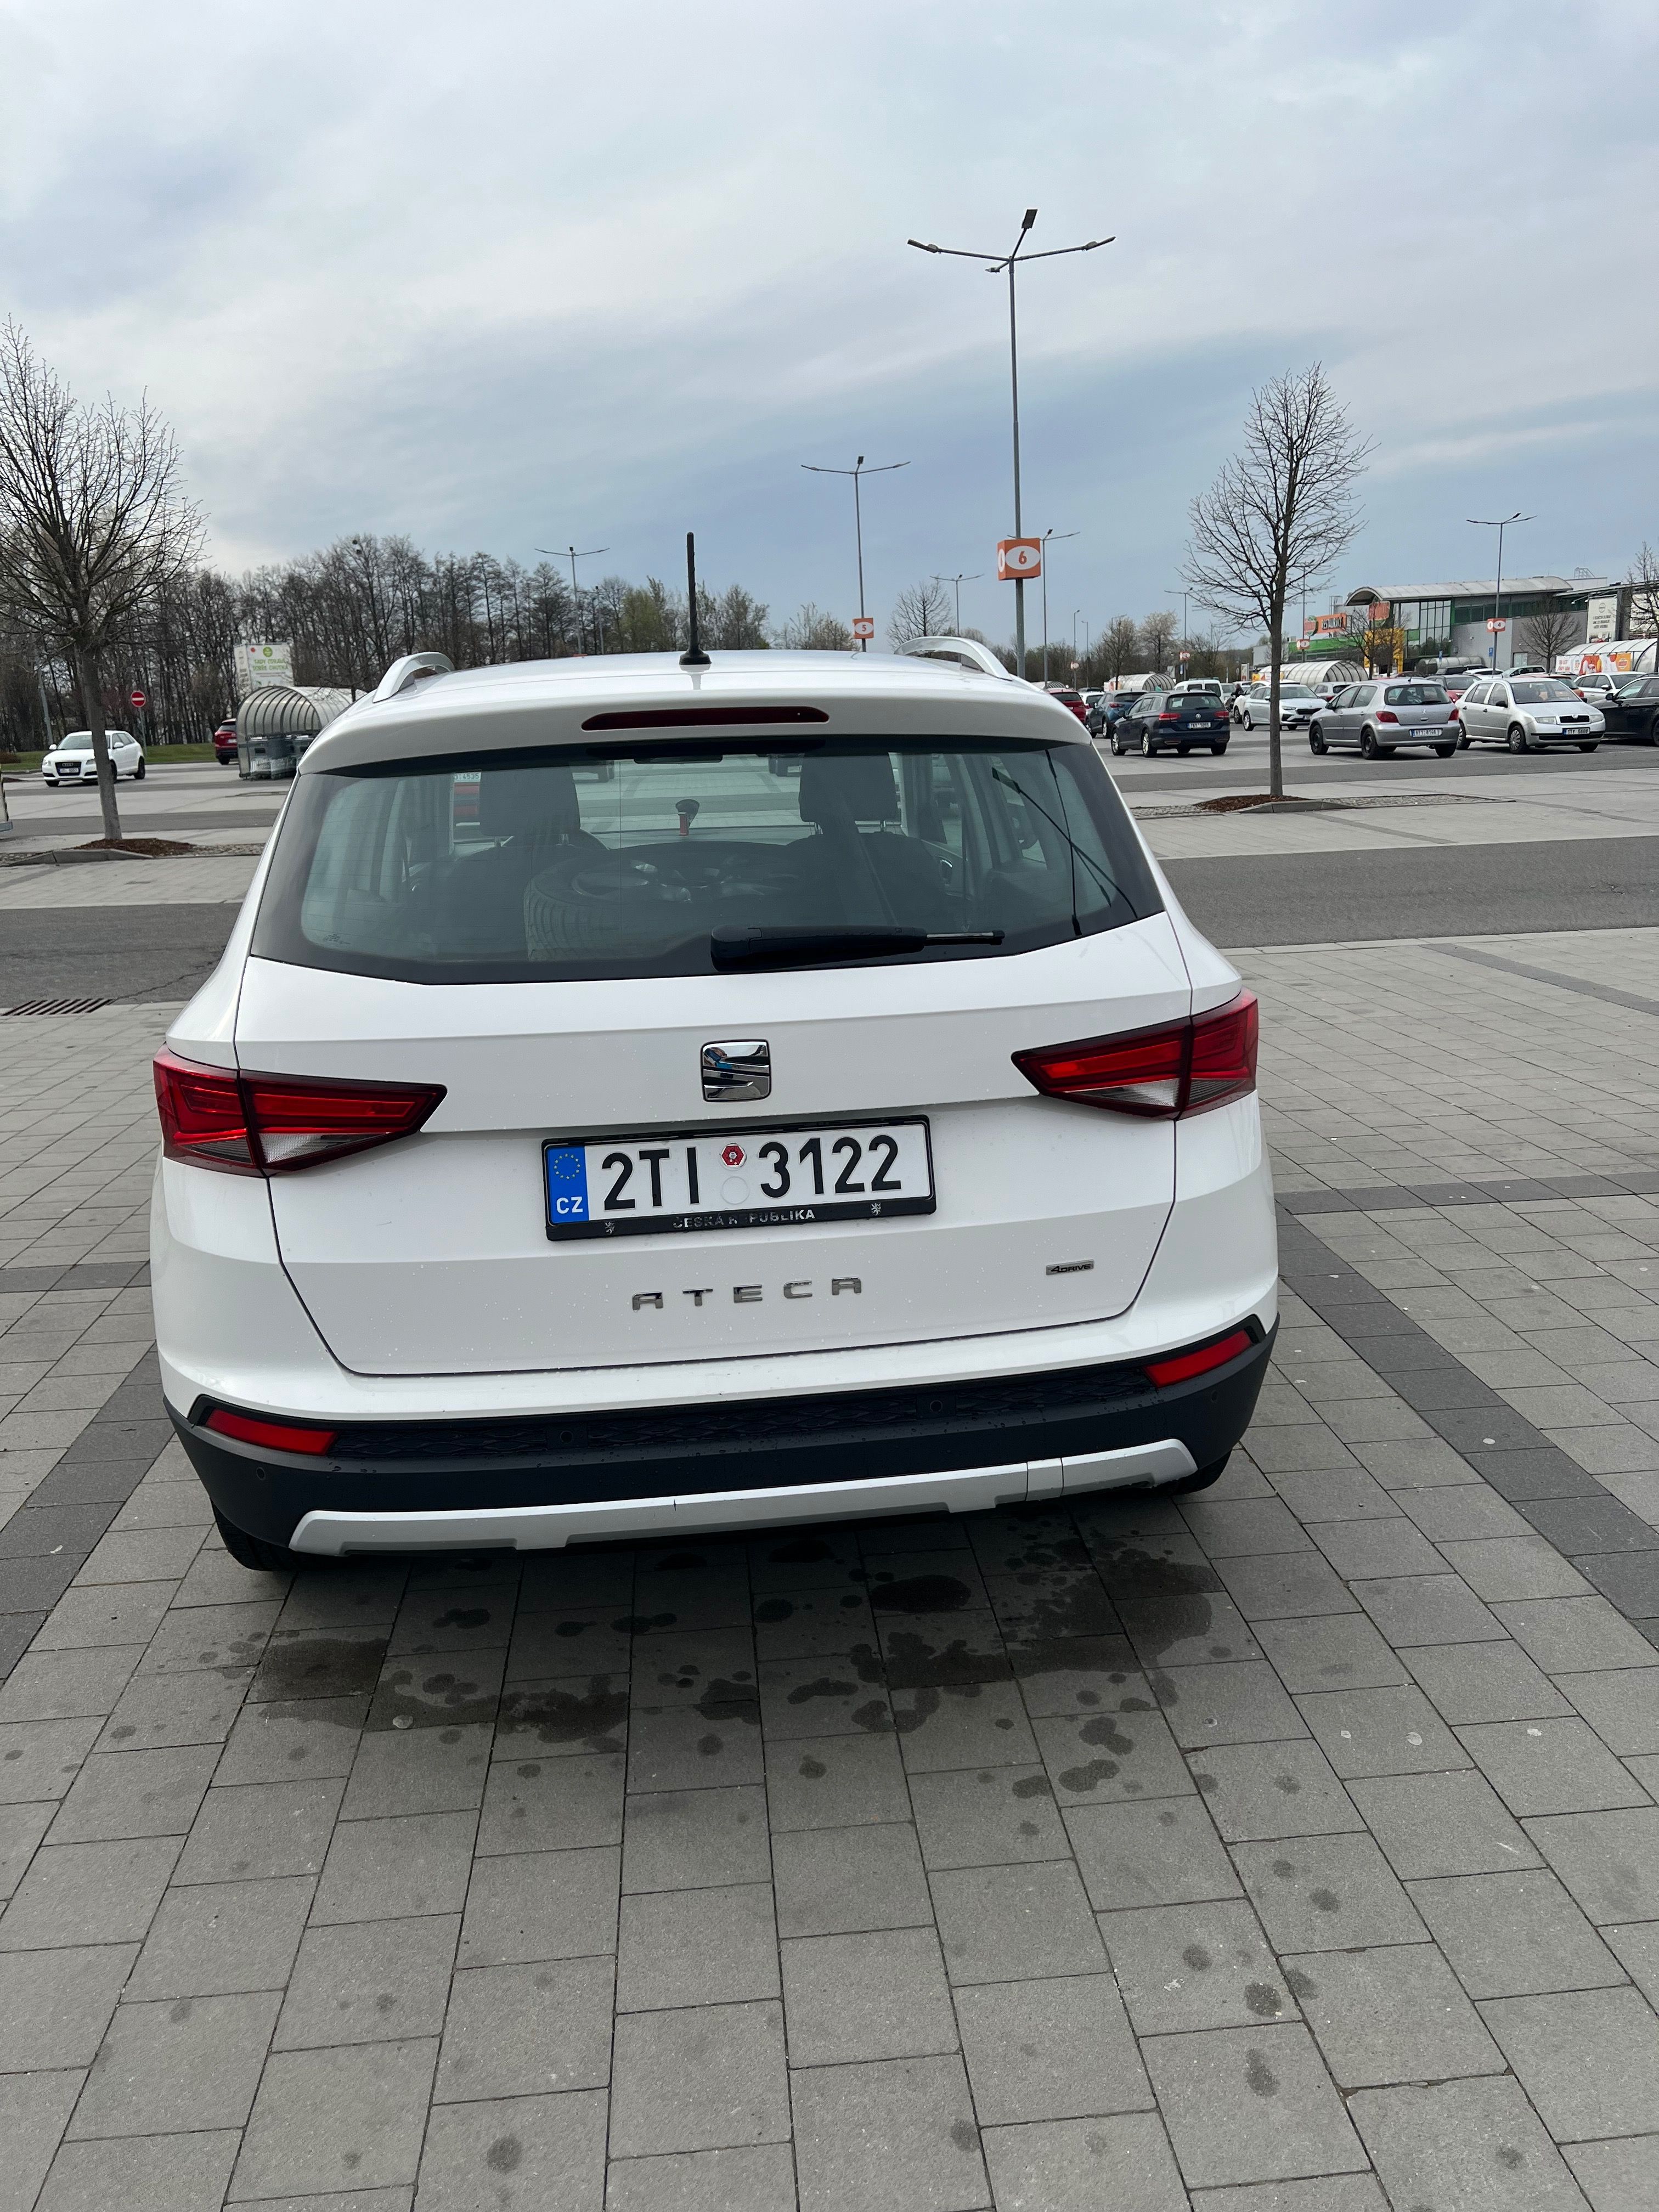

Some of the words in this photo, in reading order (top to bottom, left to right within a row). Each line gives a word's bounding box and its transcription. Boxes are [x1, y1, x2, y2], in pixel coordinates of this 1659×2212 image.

[1019, 551, 1027, 565] 6
[602, 1147, 700, 1210] 2TI
[758, 1135, 901, 1198] 3122
[557, 1197, 583, 1214] CZ
[632, 1277, 861, 1310] ATECA
